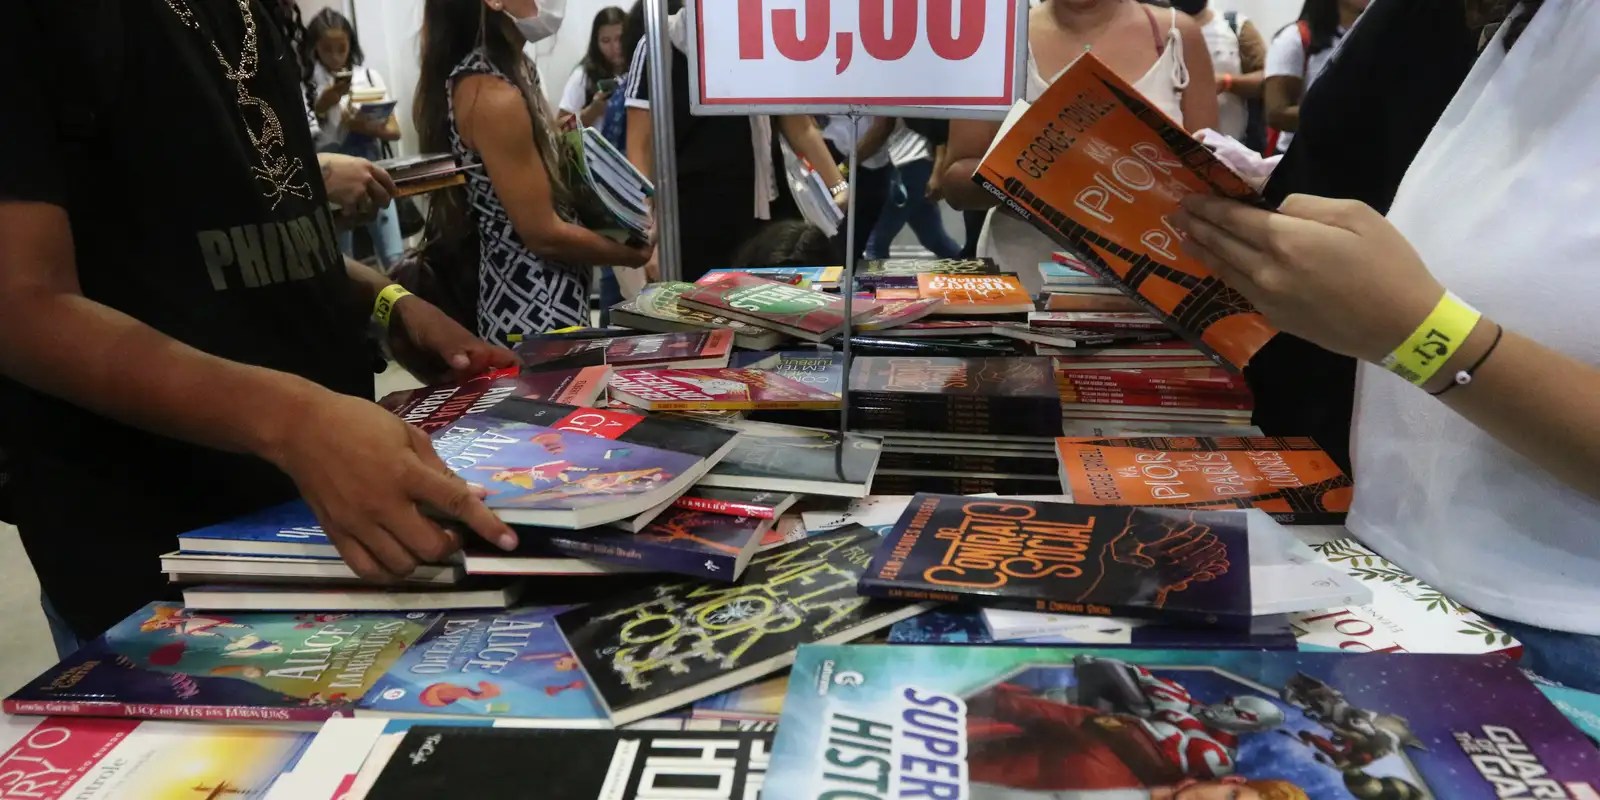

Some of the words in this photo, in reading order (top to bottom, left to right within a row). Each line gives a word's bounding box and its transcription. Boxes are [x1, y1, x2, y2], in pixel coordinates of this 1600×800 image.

[1015, 122, 1077, 180] GEORGE
[982, 181, 1008, 205] GEORGE
[1006, 199, 1032, 221] ORWELL
[1073, 142, 1183, 224] PIOR
[1135, 451, 1191, 499] PIOR
[1192, 450, 1250, 497] PARIS
[1246, 450, 1304, 488] LONDRES
[923, 501, 1037, 589] CONTRATO
[999, 515, 1096, 580] SOCIAL
[266, 621, 362, 682] ALICE
[328, 619, 407, 690] MARAVILHAS
[411, 618, 481, 675] ESPELHO
[460, 618, 545, 674] ALICE
[898, 687, 961, 800] SUPER
